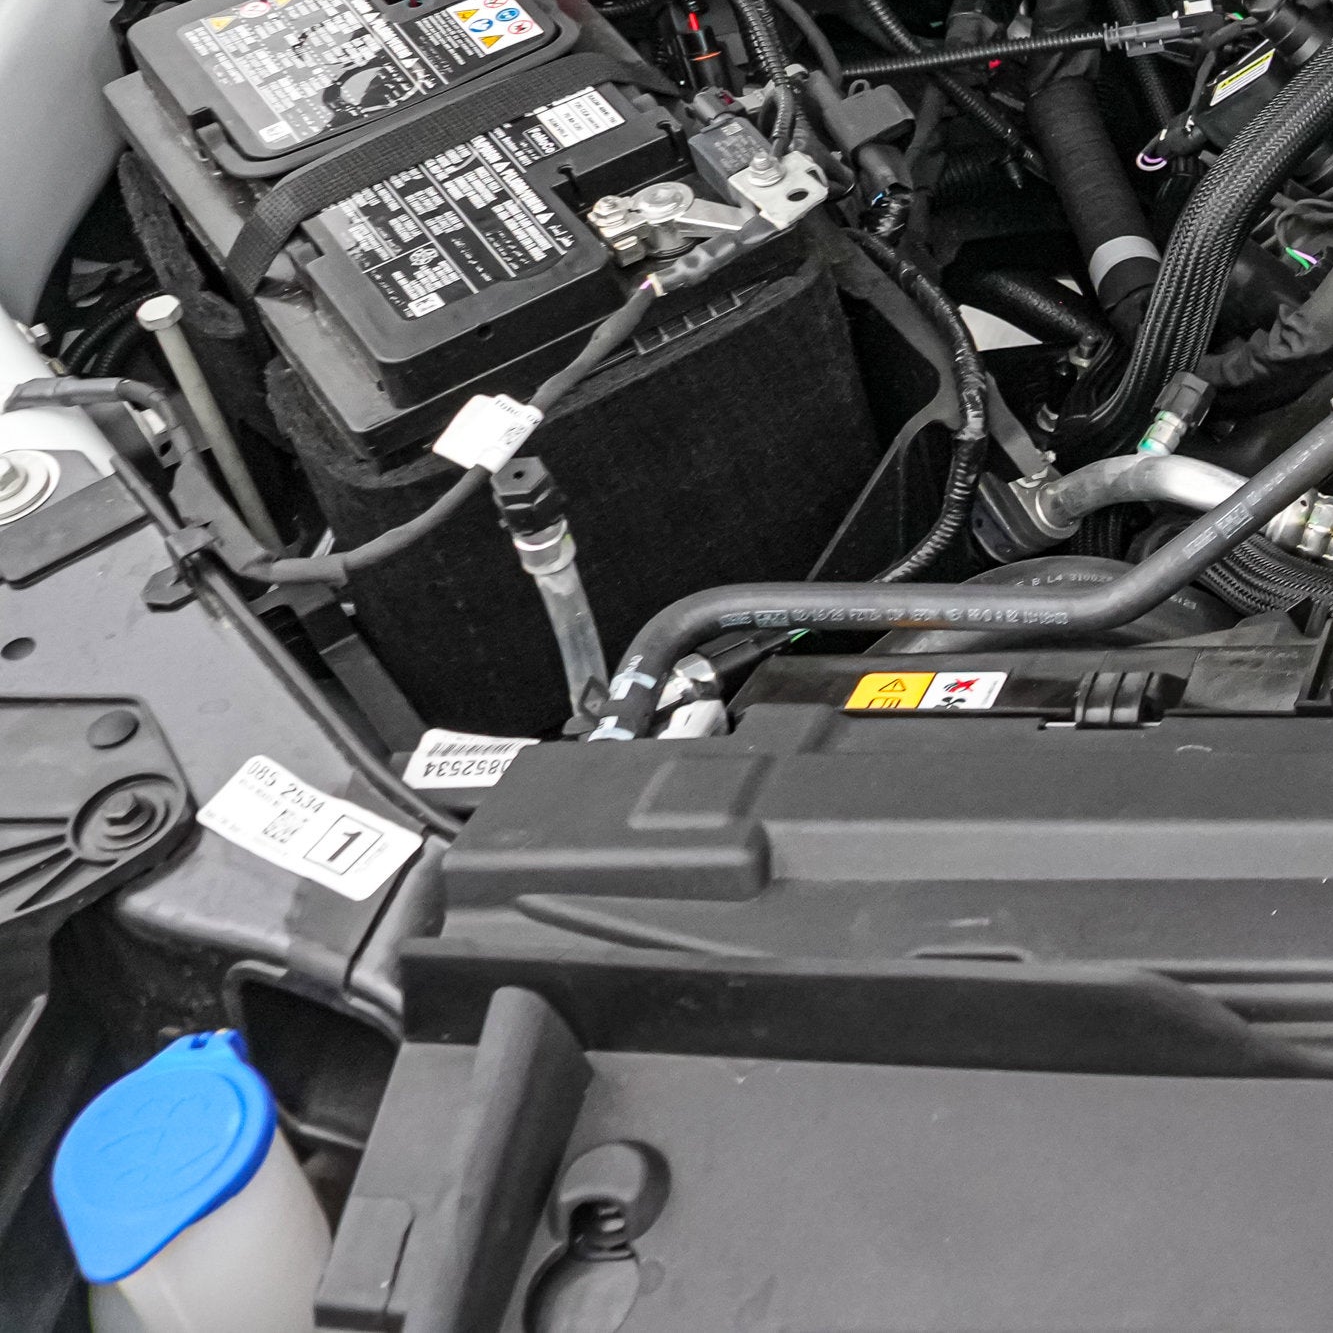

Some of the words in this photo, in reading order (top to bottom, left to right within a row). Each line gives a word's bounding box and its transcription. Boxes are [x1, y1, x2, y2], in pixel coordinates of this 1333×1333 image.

[247, 760, 277, 788] 085
[277, 783, 326, 814] 2534
[327, 829, 360, 864] 1
